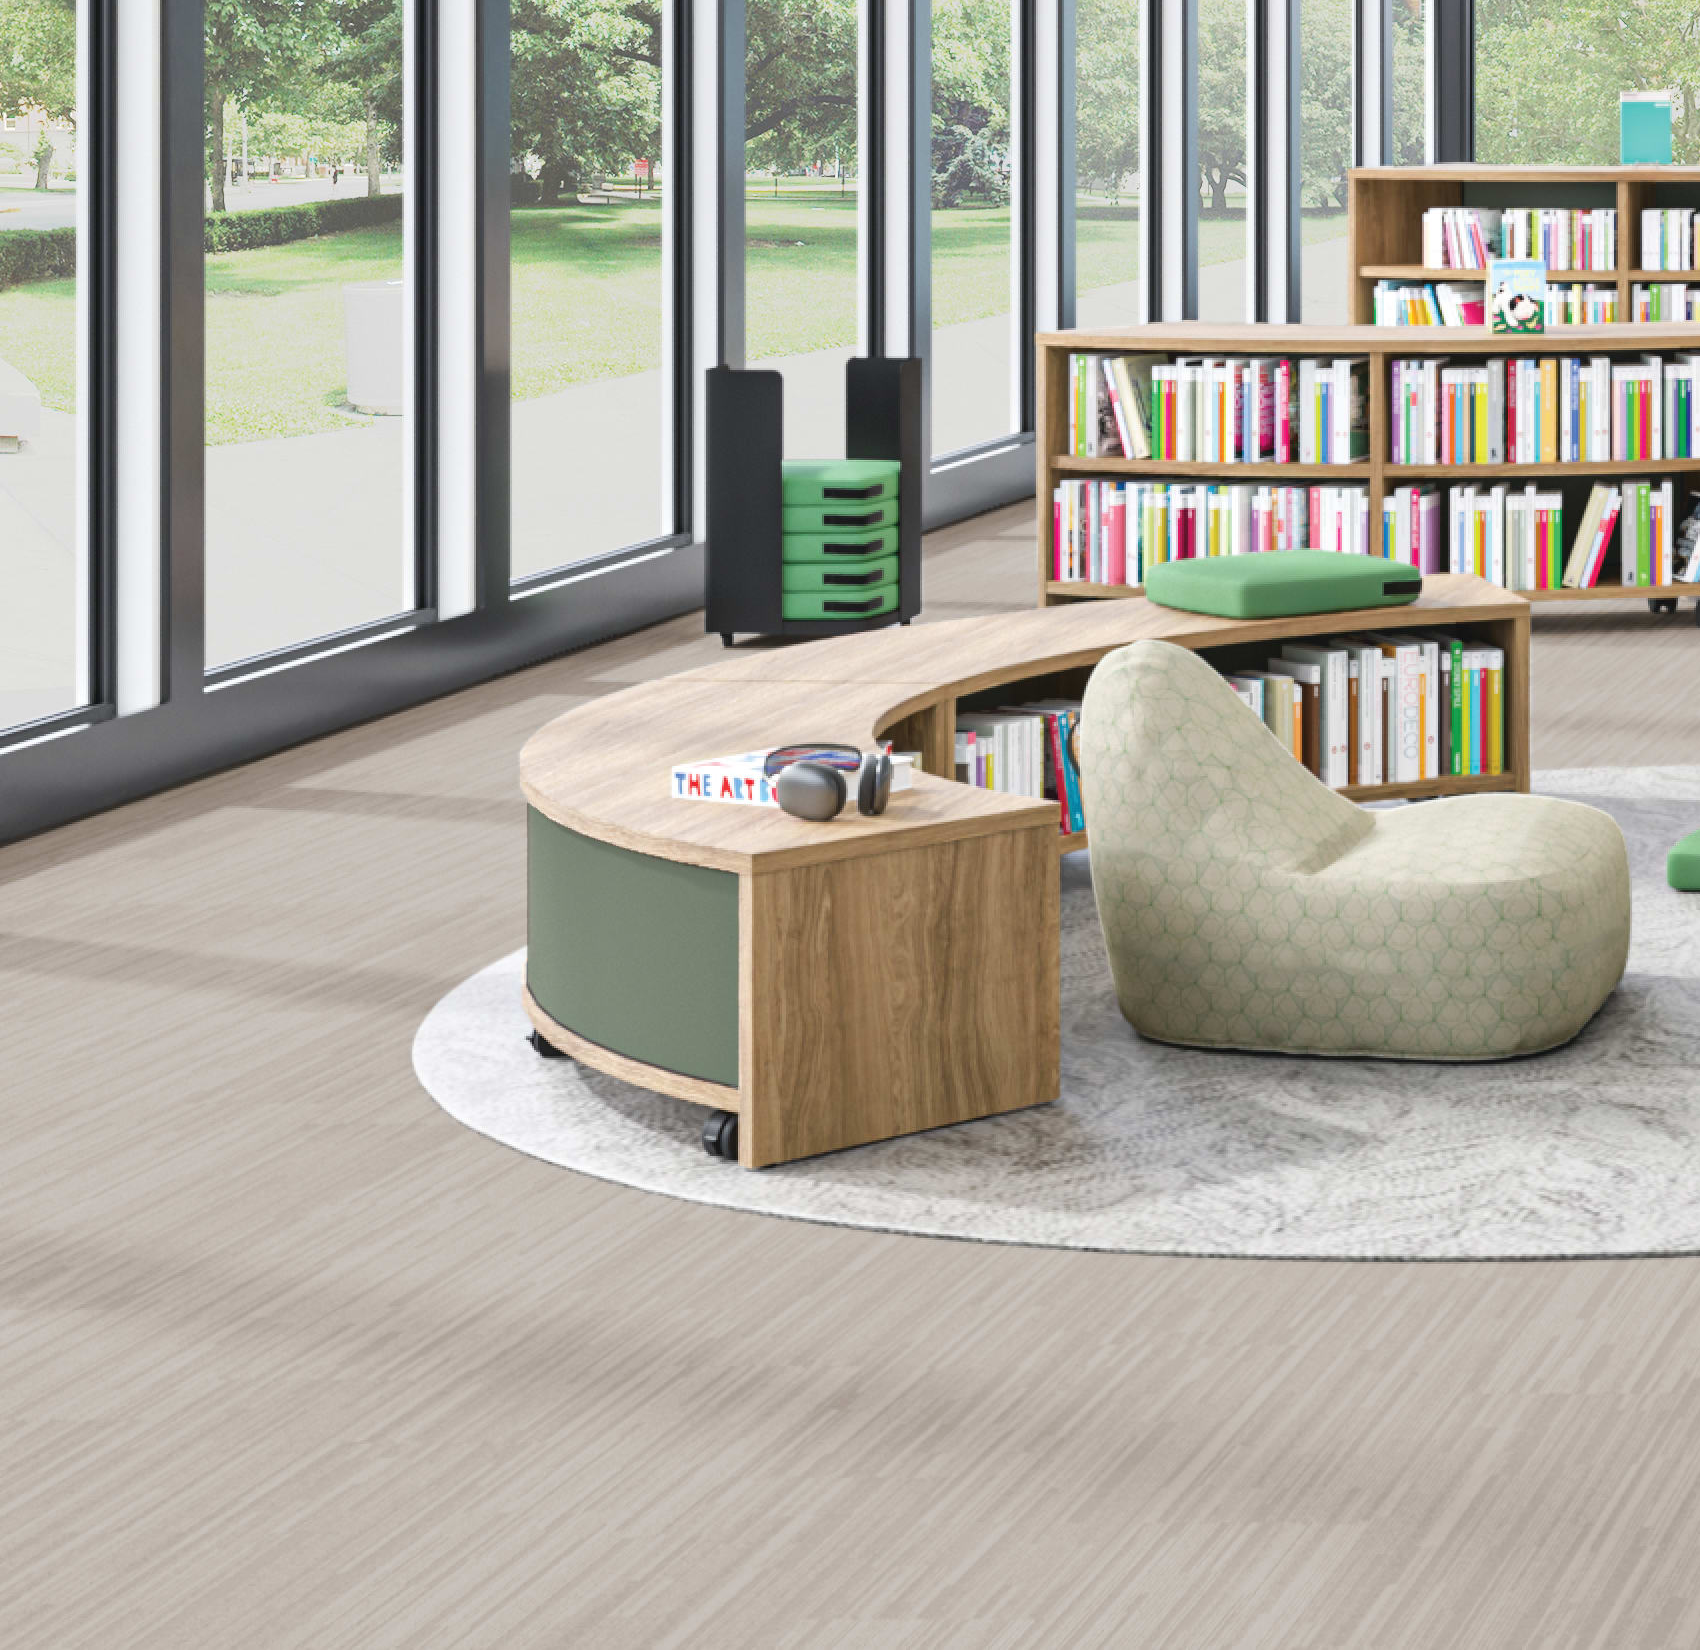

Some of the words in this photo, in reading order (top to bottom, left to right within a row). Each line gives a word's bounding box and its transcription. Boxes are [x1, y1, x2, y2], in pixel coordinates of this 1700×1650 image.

[1403, 651, 1420, 759] EURODECO
[674, 772, 712, 797] THE
[719, 776, 755, 801] ART
